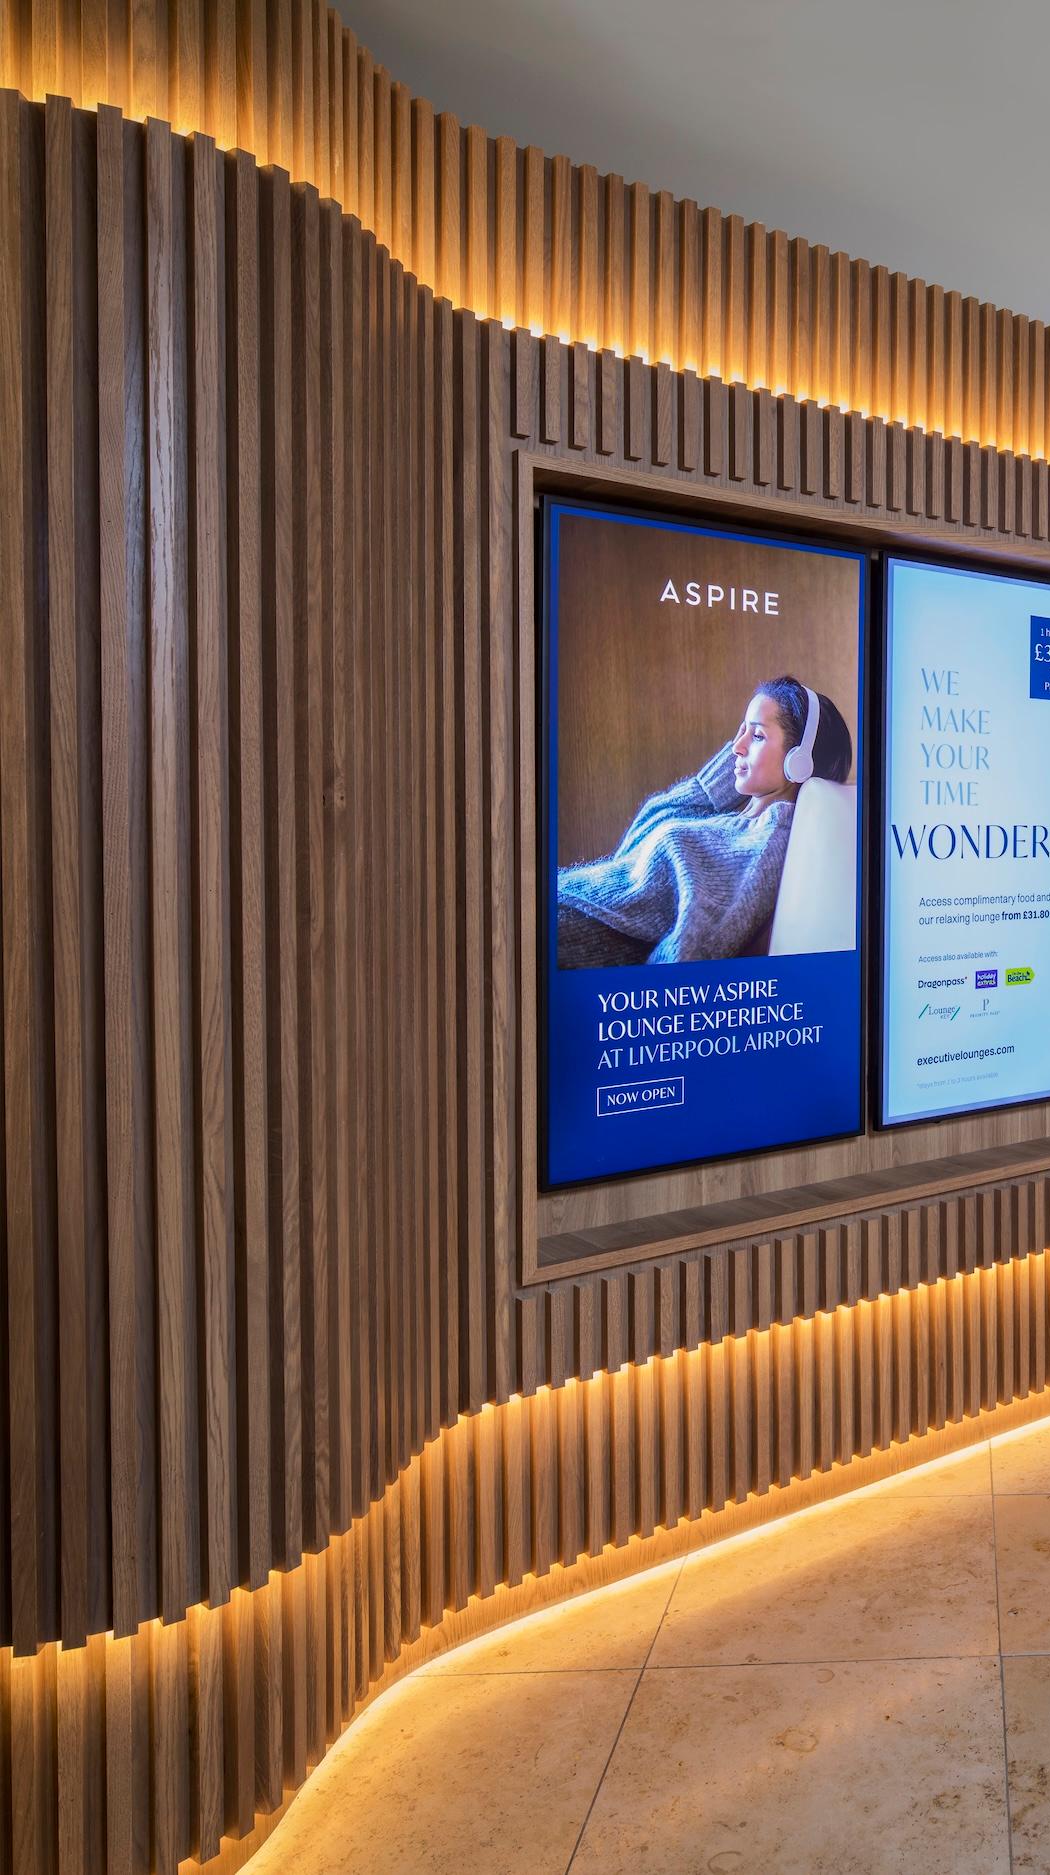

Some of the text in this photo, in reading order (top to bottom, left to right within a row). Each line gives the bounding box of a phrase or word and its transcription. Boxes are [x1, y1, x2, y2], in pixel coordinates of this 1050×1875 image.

[660, 579, 779, 615] ASPIRE
[1041, 628, 1044, 637] 1
[921, 668, 960, 697] WE
[920, 706, 991, 735] MAKE
[920, 743, 990, 771] YOUR
[920, 780, 979, 807] TIME
[919, 897, 953, 907] Access
[954, 894, 1016, 907] complimentary
[1017, 893, 1035, 903] food
[1036, 892, 1050, 902] and
[919, 916, 933, 926] our
[936, 913, 970, 926] relaxing
[972, 912, 1000, 924] lounge
[1002, 911, 1021, 921] from
[1023, 910, 1050, 920] £31.80
[918, 955, 942, 964] Access
[957, 952, 983, 960] available
[1007, 974, 1026, 983] Beach
[598, 979, 778, 1013] YOUR NEW ASPIRE
[599, 1002, 804, 1041] LOUNGE EXPERIENCE
[929, 1006, 956, 1016] Lounge
[598, 1025, 824, 1070] AT LIVERPOOL AIRPORT
[917, 1044, 1015, 1067] executivelounges.com
[607, 1086, 676, 1107] NOW OPEN
